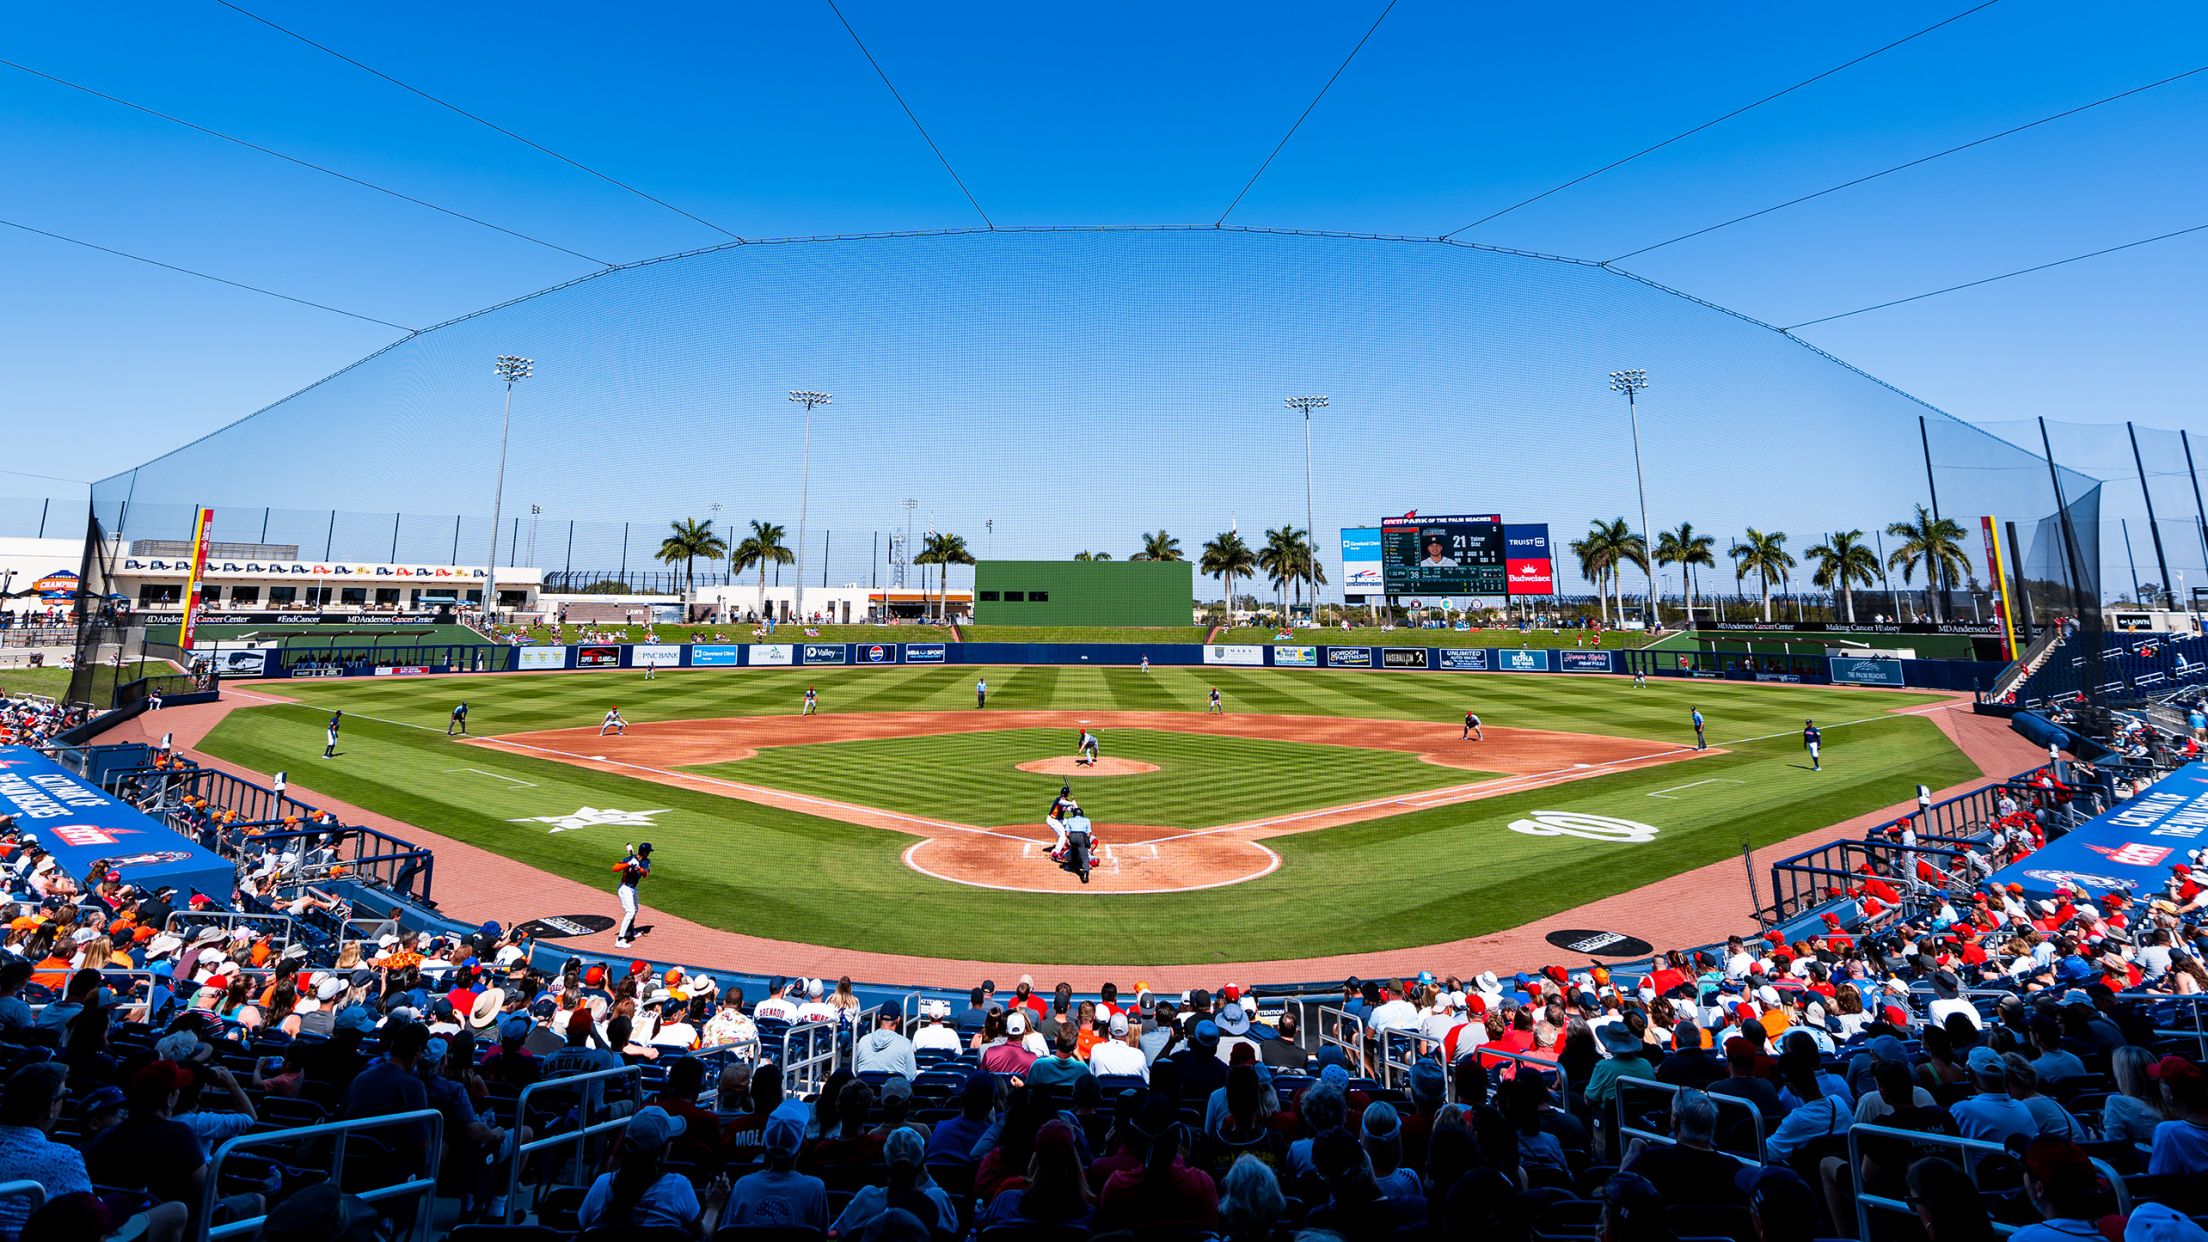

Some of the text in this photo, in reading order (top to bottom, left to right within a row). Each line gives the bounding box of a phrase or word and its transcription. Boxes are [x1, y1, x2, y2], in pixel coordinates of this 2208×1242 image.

[1452, 535, 1466, 548] 21
[1826, 624, 1850, 632] Making
[818, 649, 836, 658] Valley
[65, 798, 112, 806] OF
[2150, 824, 2204, 838] THE
[736, 1129, 764, 1148] MOL
